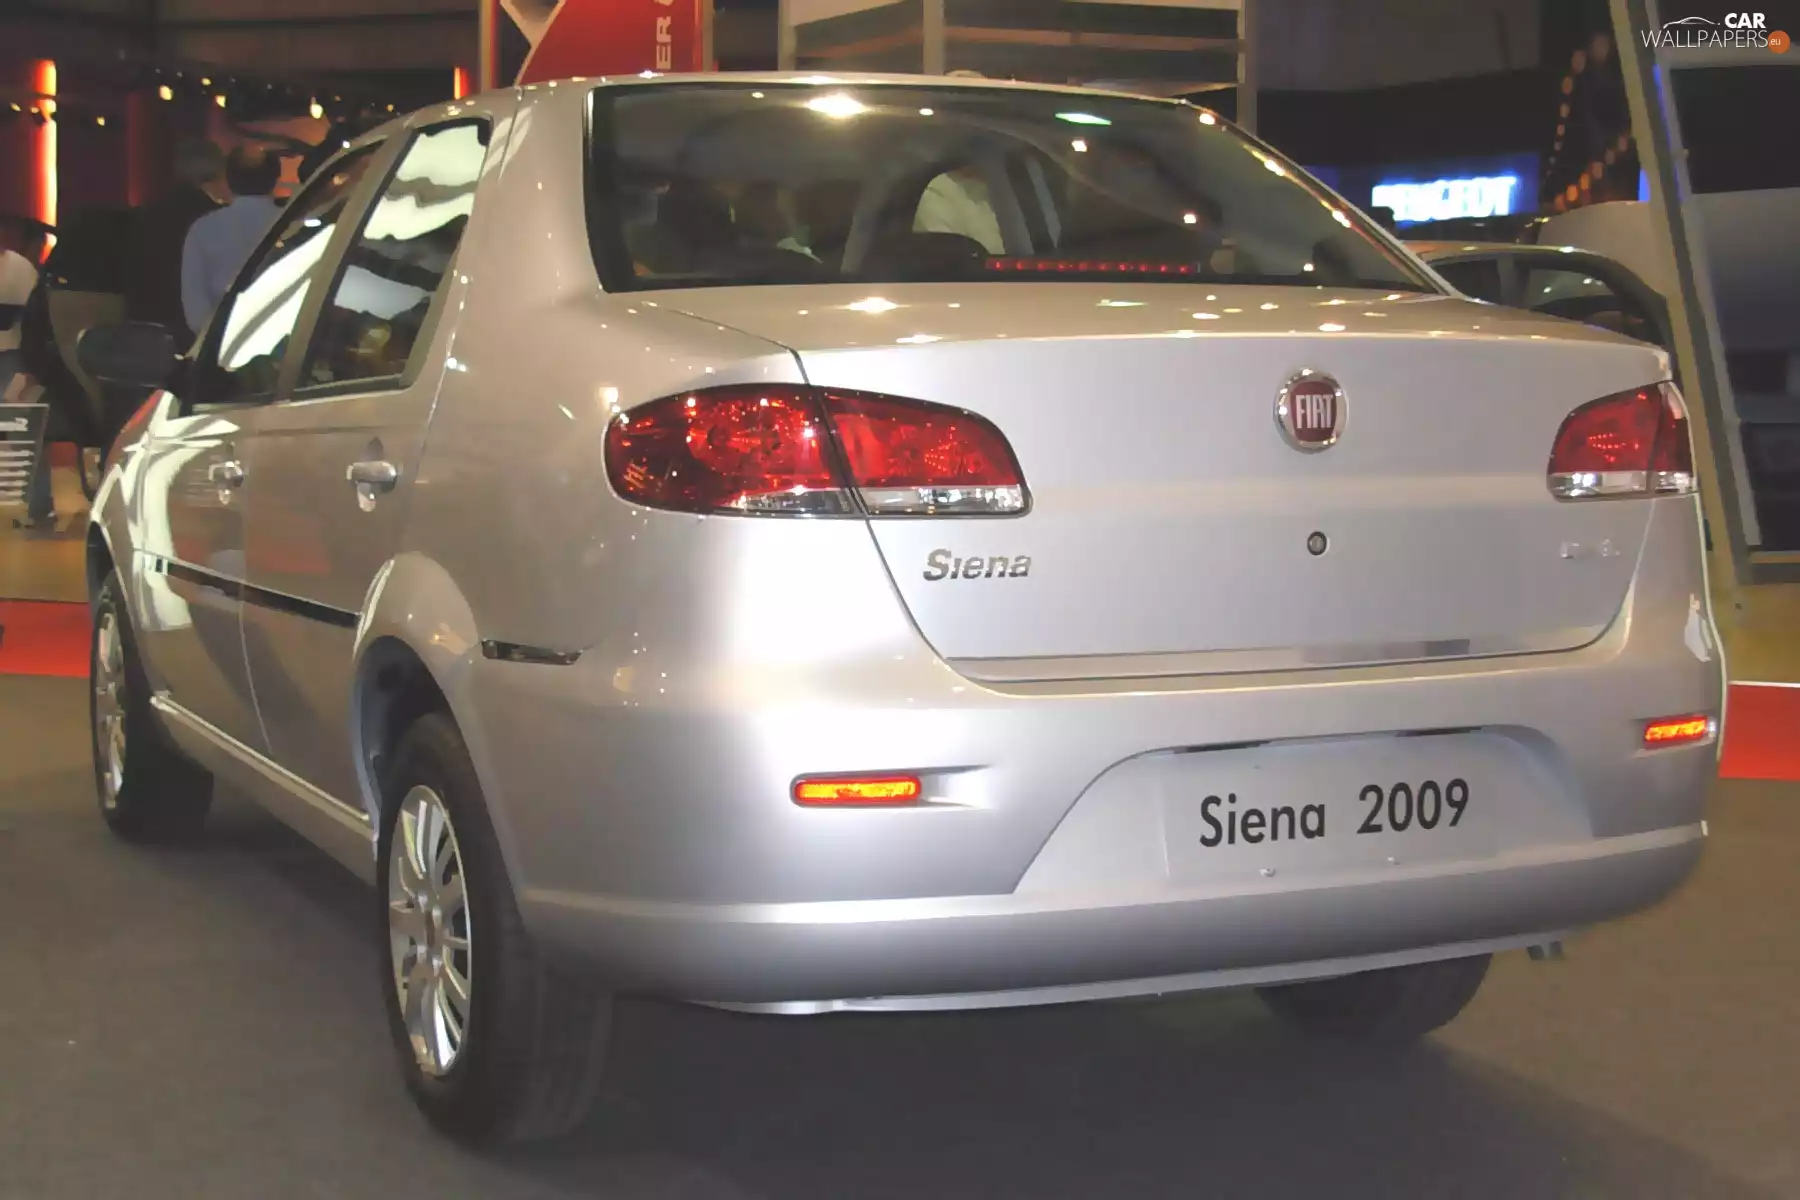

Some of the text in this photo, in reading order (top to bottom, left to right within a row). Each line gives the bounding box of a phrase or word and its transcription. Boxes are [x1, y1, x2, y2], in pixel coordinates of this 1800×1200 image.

[1295, 394, 1334, 428] FIAT
[922, 548, 1032, 581] Siena
[1200, 778, 1470, 847] Siena 2009
